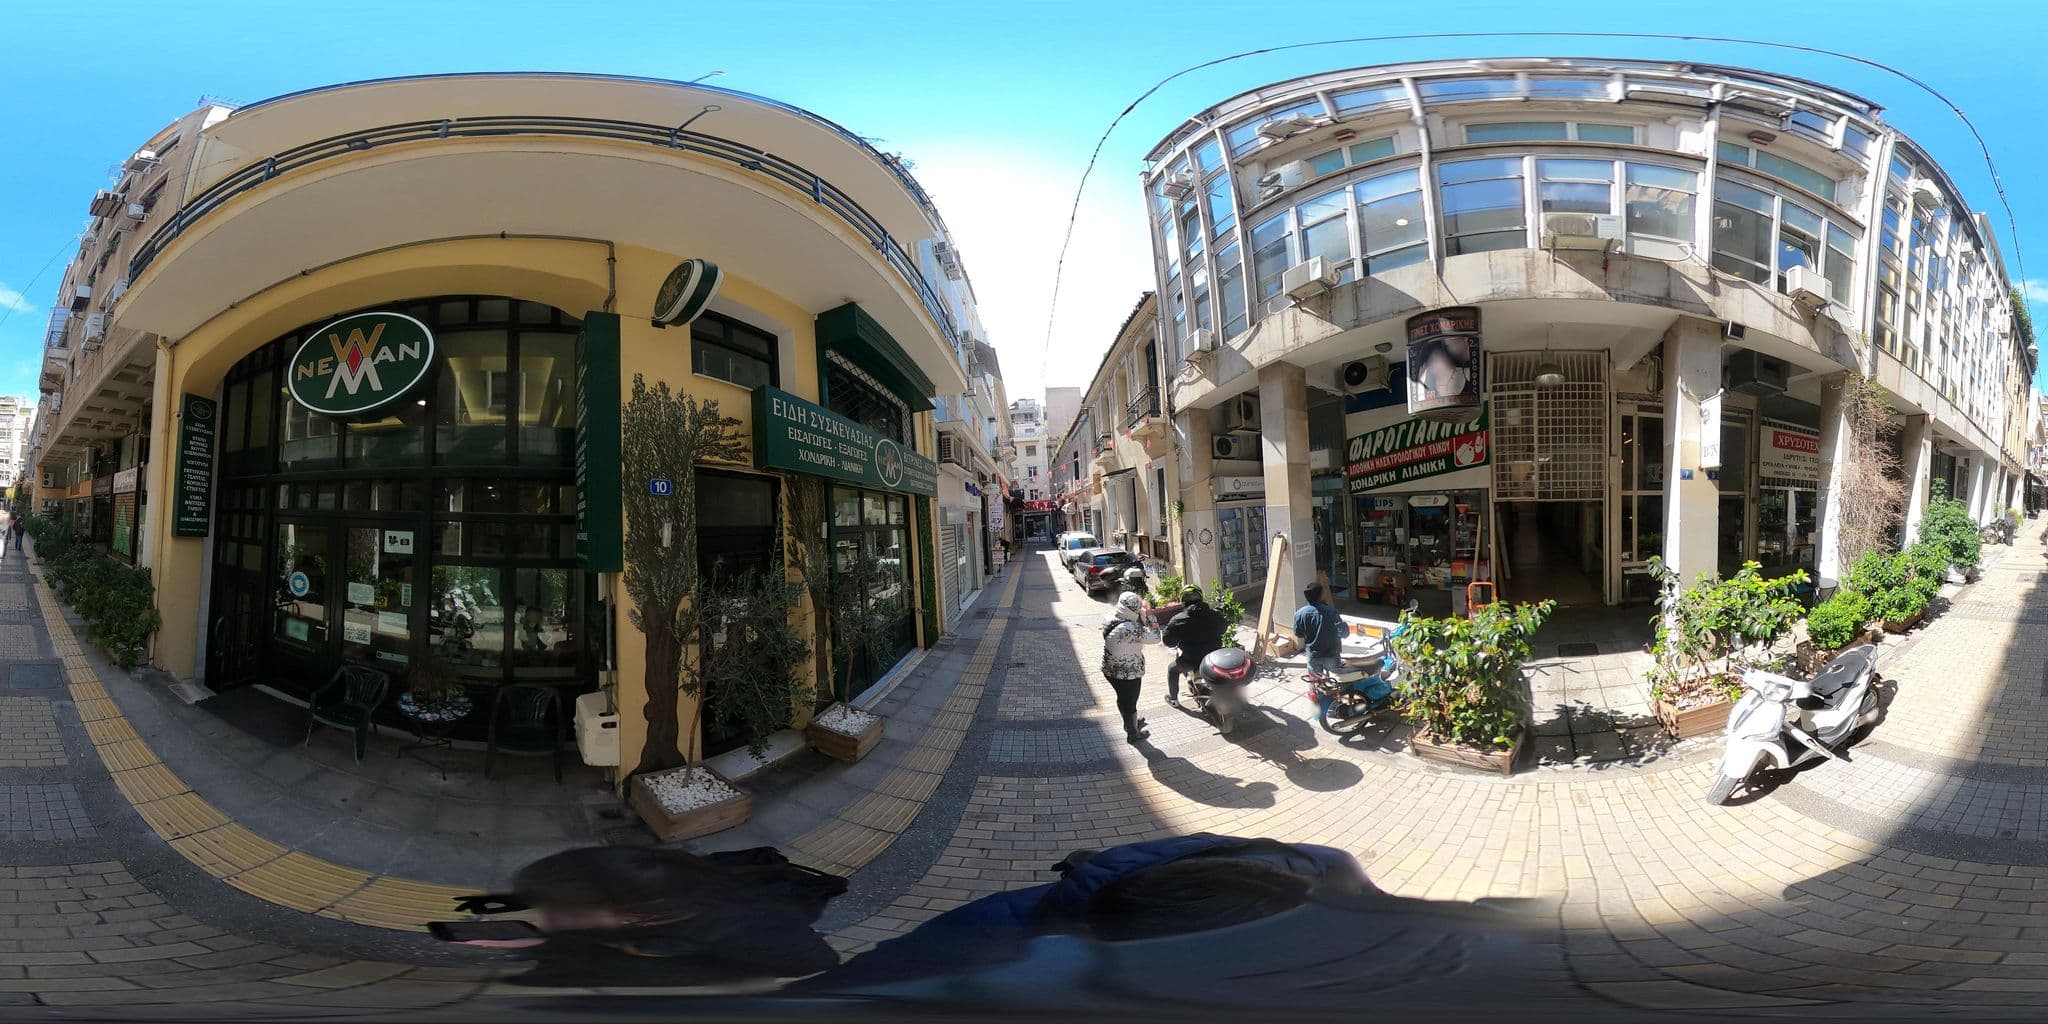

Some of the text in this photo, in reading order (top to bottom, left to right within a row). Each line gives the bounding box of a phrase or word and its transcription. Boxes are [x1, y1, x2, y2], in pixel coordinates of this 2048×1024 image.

[773, 397, 874, 449] ΕΙΔΗ ΣΥΣΚΕΥΑΣΙΑΣ
[788, 426, 868, 462] ΕΙΣΑΓΩΓΕΣ ΕΞΑΓΩΓΕΣ
[798, 448, 836, 468] ΧΟΝΔΡΙΚΗ
[1349, 440, 1450, 475] ΑΠΟΘΗΚΗ ΗΛΕΚΤΡΟΛΟΓΙΚΟΥ ΥΛΙΚΟΥ
[655, 481, 667, 493] 10
[1350, 459, 1446, 491] ΧΟΝΔΡΙΚΗ ΛΙΑΝΙΚΗ
